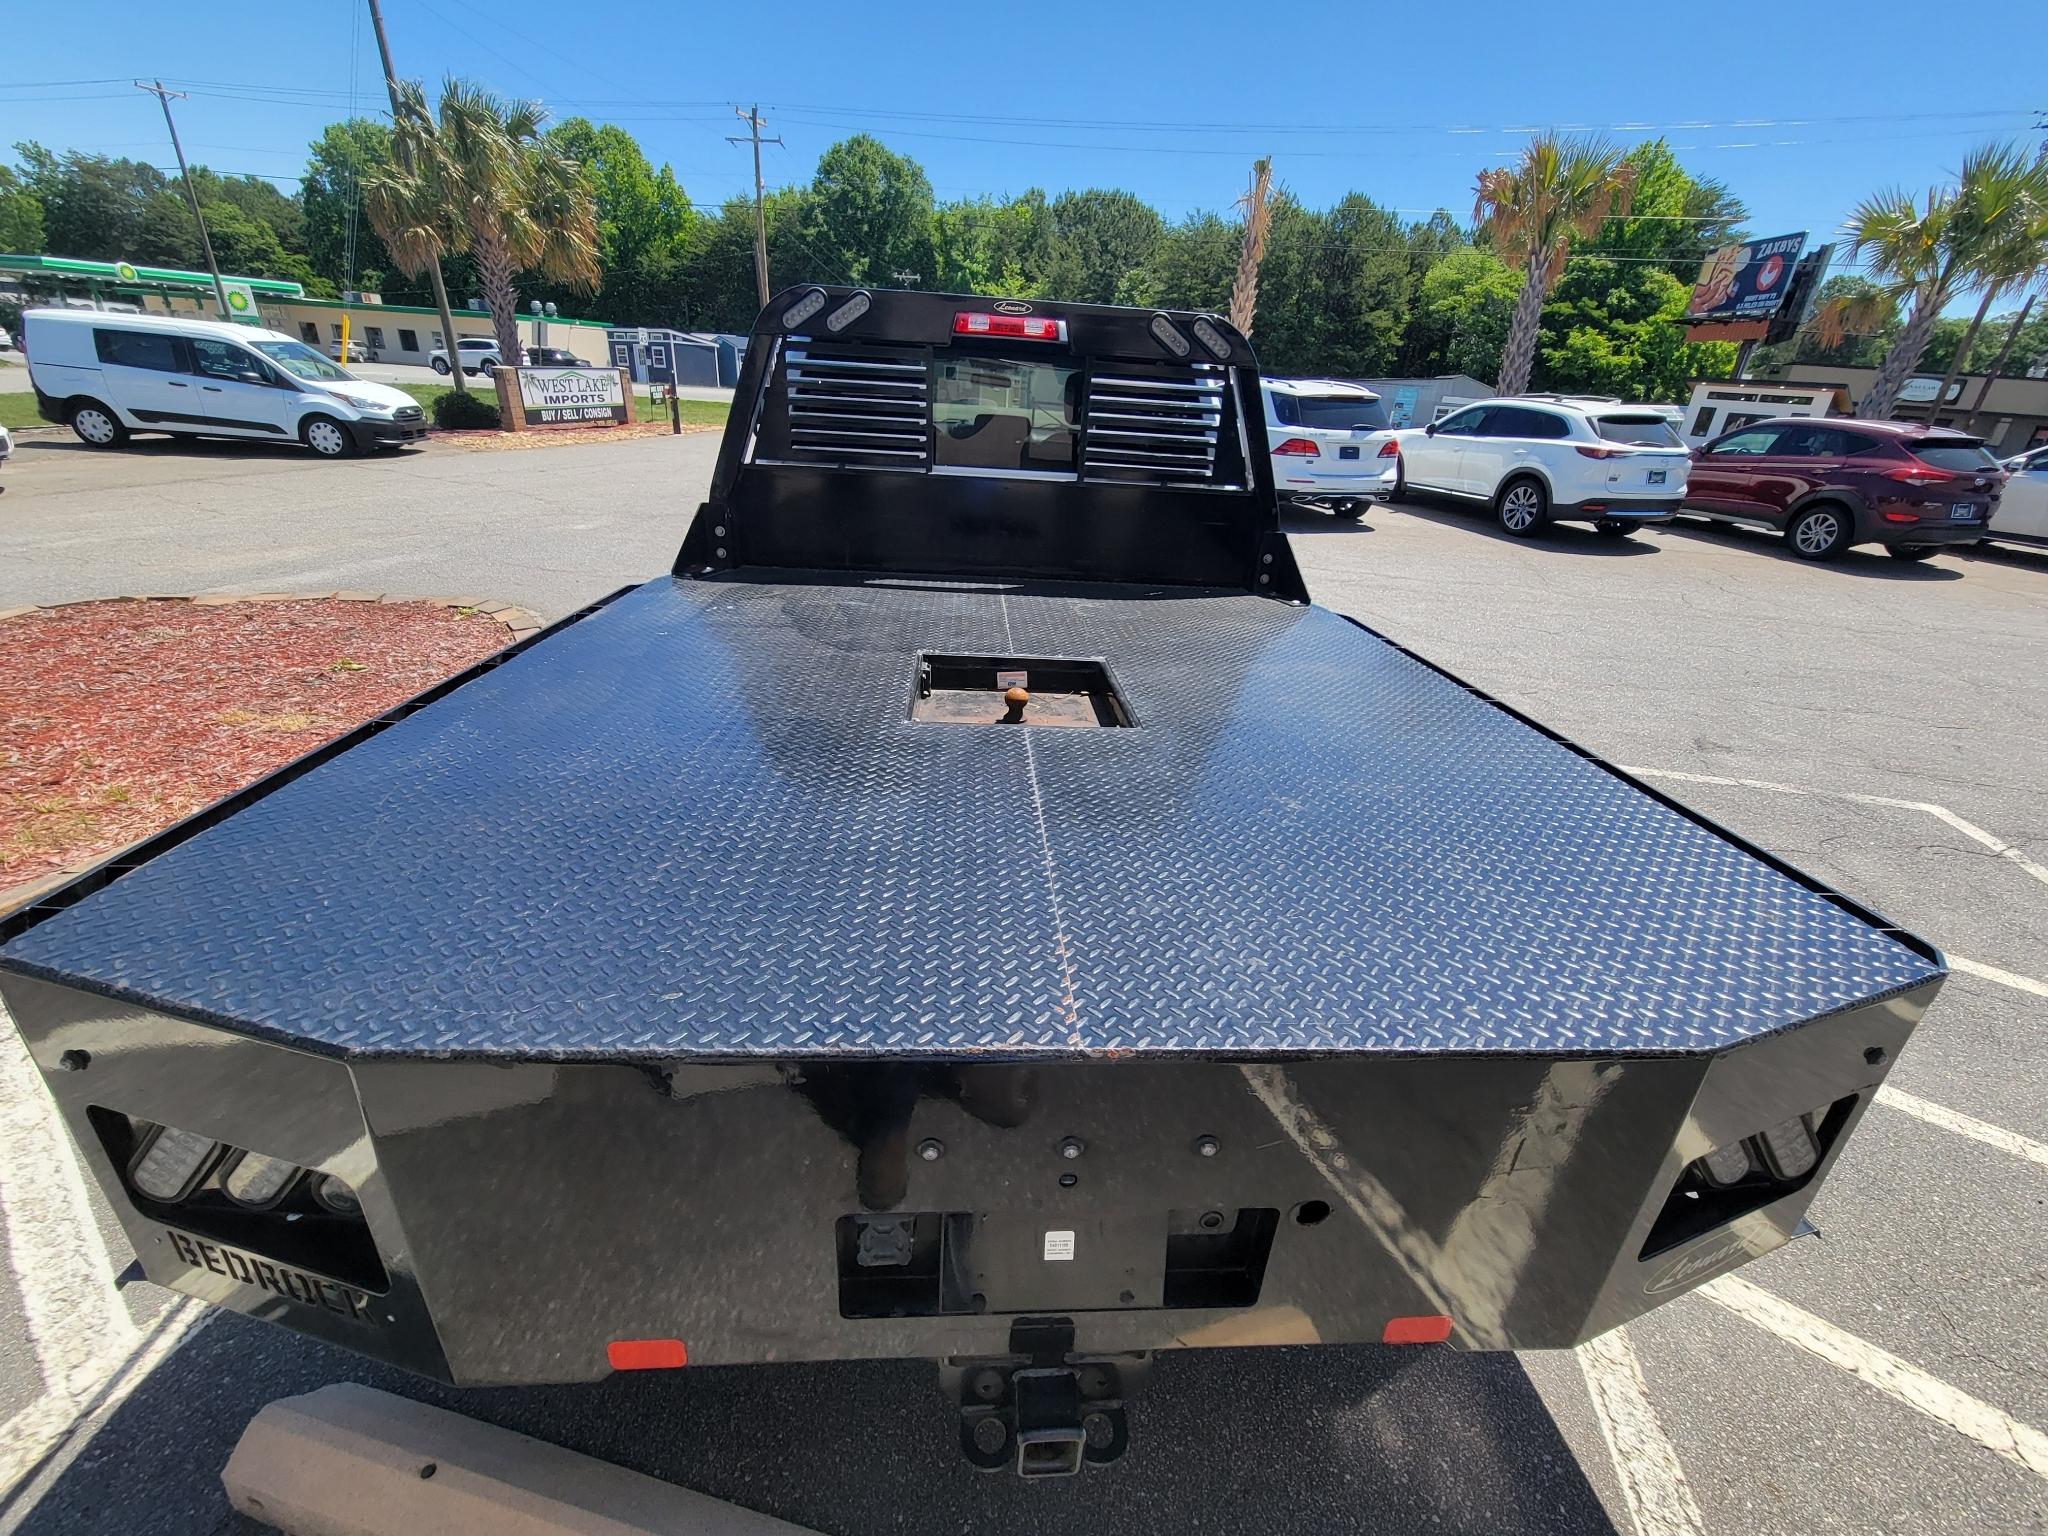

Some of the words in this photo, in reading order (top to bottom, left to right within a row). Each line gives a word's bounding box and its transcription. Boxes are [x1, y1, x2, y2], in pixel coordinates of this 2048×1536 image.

[1756, 237, 1802, 260] ZAXBYS
[536, 378, 576, 393] WEST
[576, 378, 608, 392] LAKE
[544, 394, 606, 405] IMPORTS
[541, 409, 556, 421] BUY
[562, 408, 579, 420] SELL
[583, 407, 612, 420] CONSIGN
[166, 1230, 377, 1324] BEDROCK
